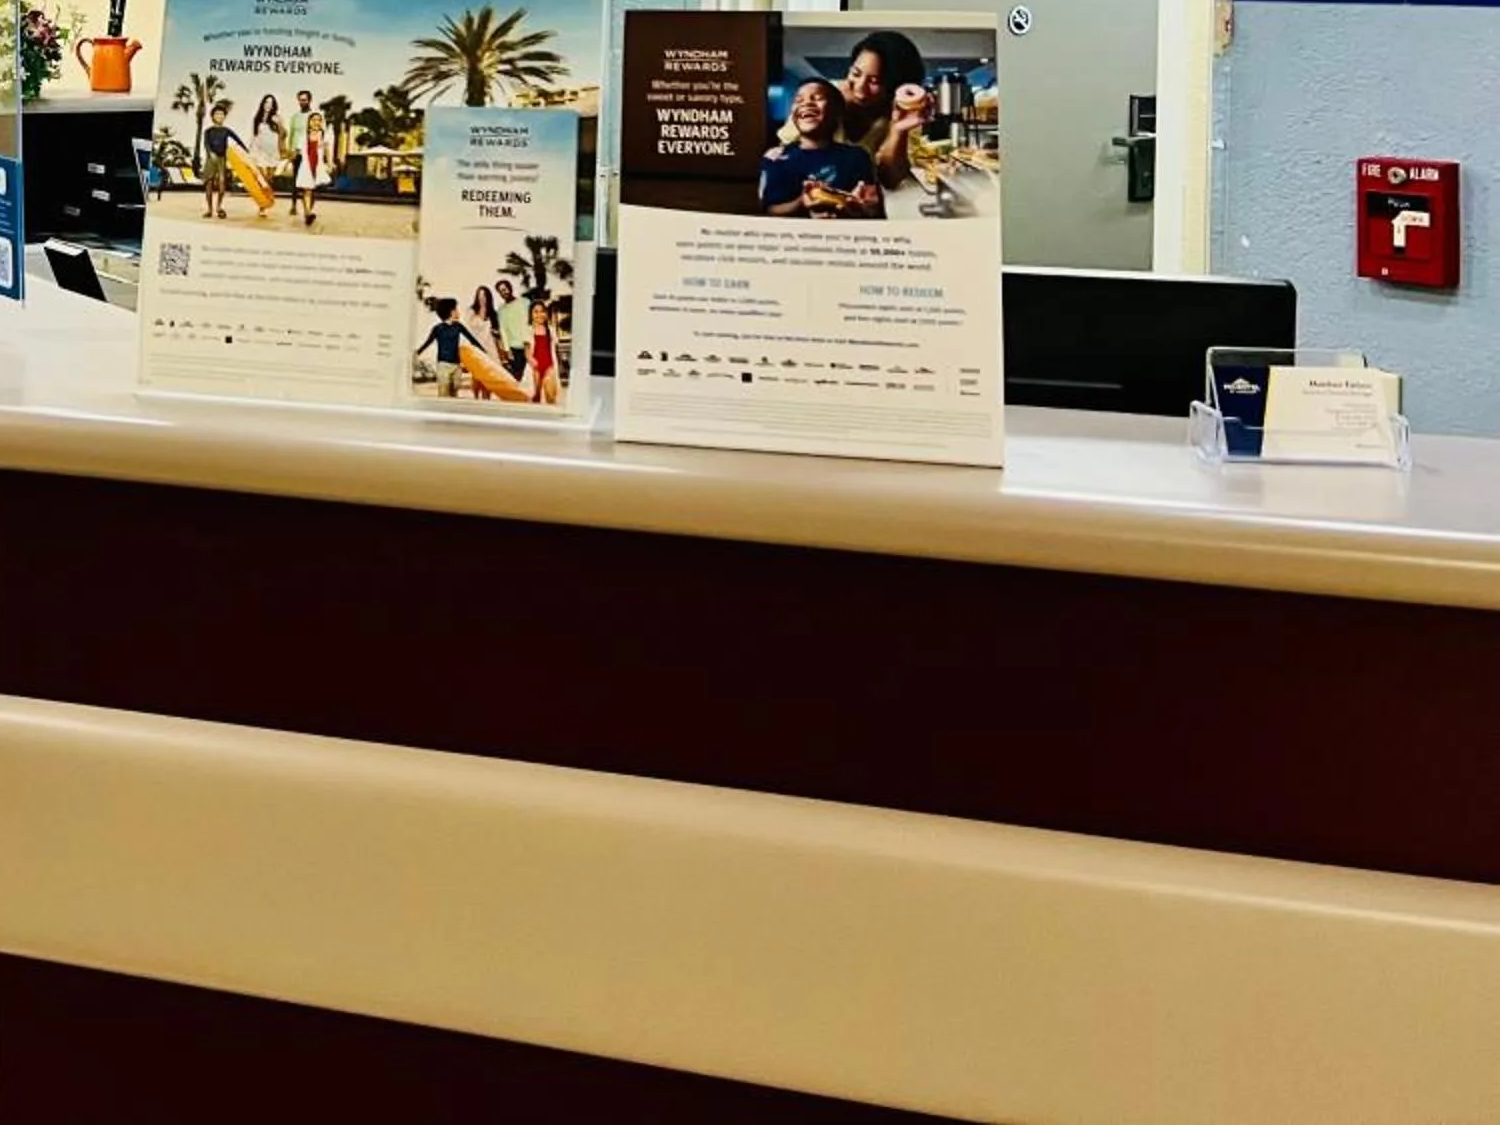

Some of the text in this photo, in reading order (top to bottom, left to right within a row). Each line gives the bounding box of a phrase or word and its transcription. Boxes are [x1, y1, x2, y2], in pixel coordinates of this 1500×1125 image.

[243, 45, 312, 57] WYNDHAM
[664, 50, 728, 59] WYNDHAM
[209, 59, 345, 75] REWARDS EVERYONE.
[664, 61, 727, 72] REWARDS
[656, 108, 733, 123] WYNDHAM
[661, 124, 729, 140] REWARDS
[657, 140, 735, 156] EVERYONE.
[461, 190, 531, 203] REDEEMING
[479, 204, 516, 218] THEM.
